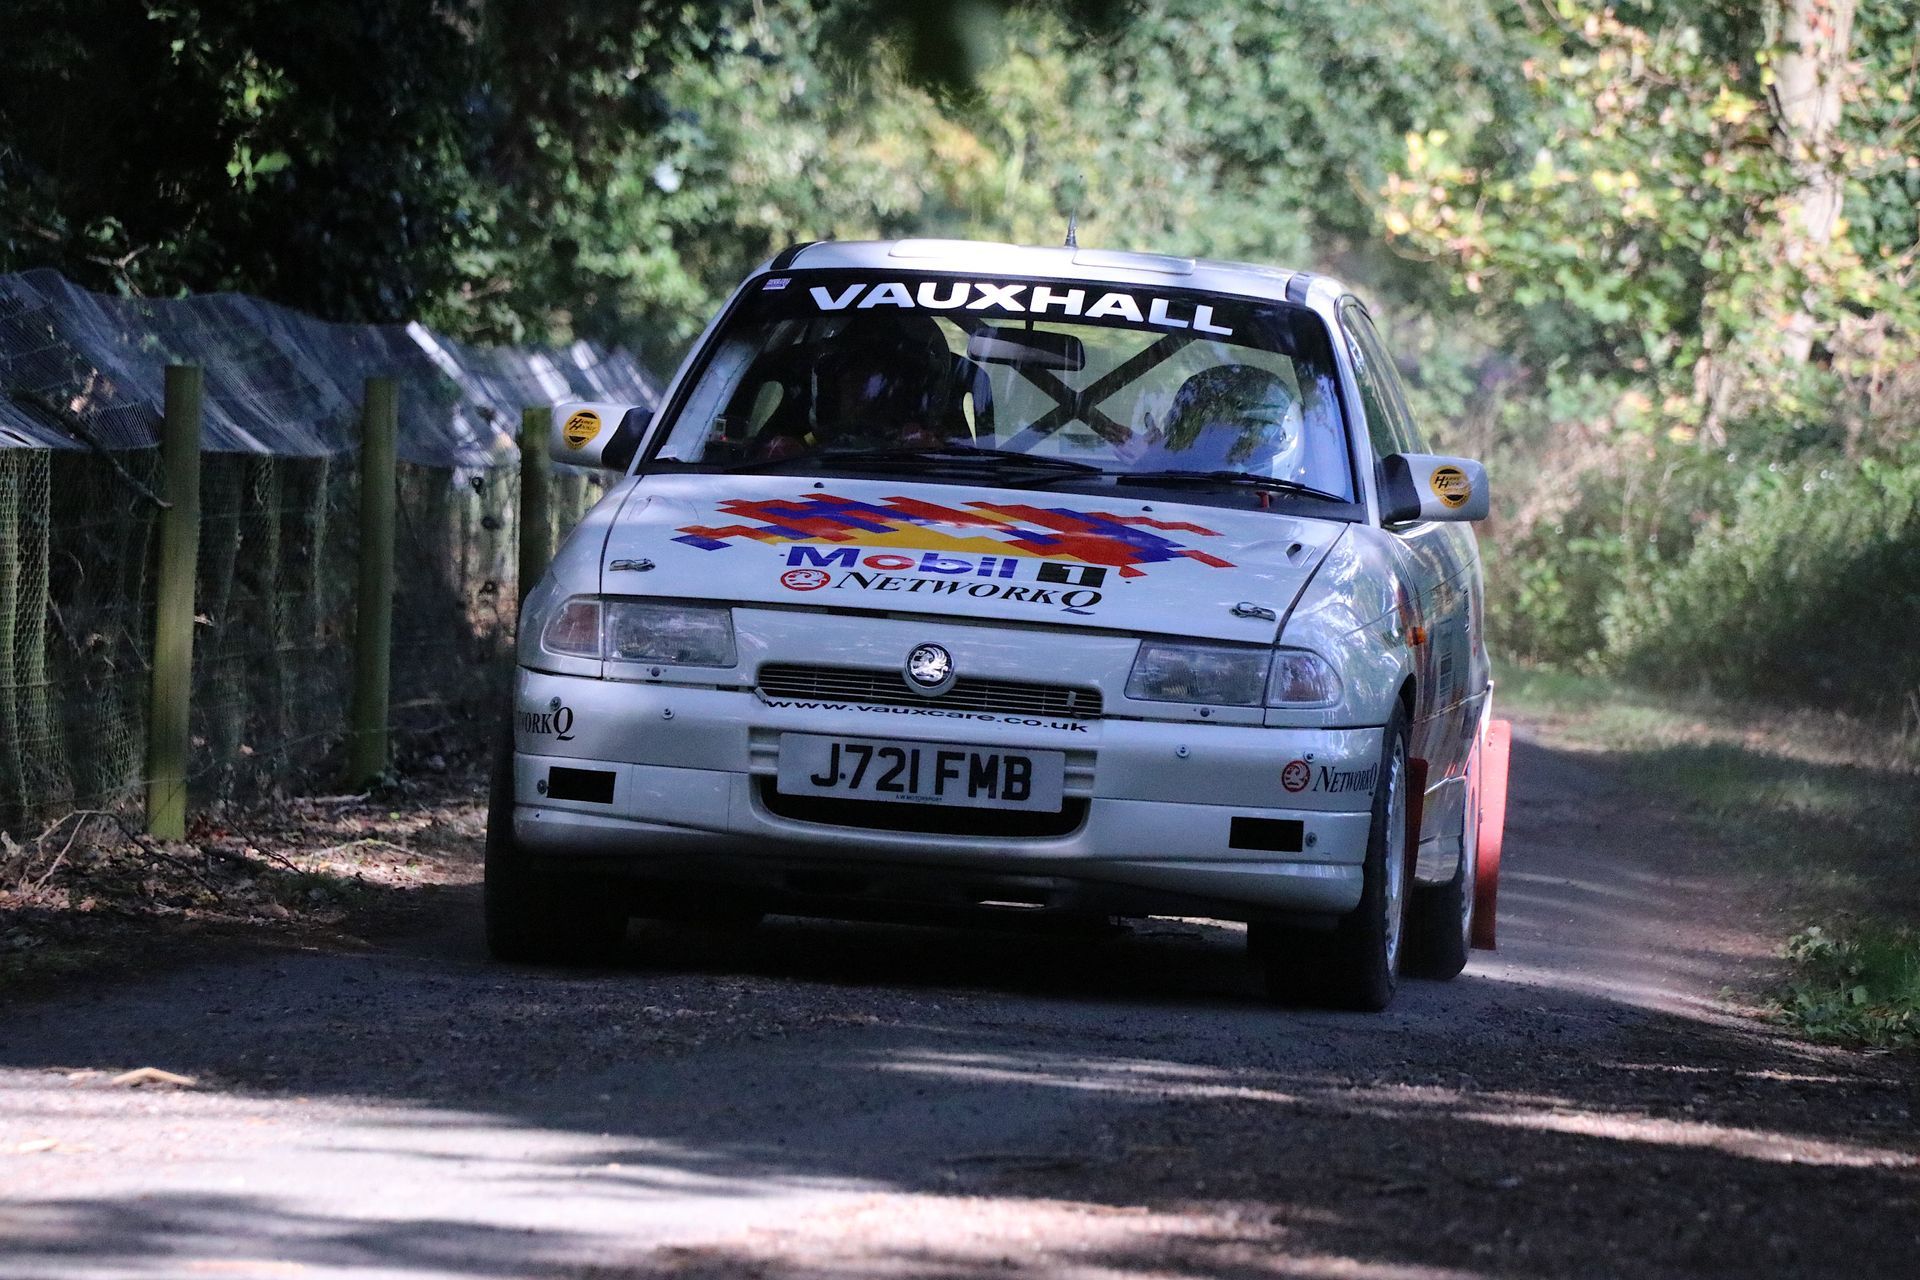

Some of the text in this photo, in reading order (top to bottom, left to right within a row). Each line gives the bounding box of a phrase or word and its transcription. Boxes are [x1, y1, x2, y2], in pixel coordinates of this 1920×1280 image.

[809, 282, 1233, 335] VAUXHALL
[786, 546, 1018, 579] Mobil
[765, 700, 1088, 733] www.vauxcare.co.uk
[935, 751, 1033, 802] FMB
